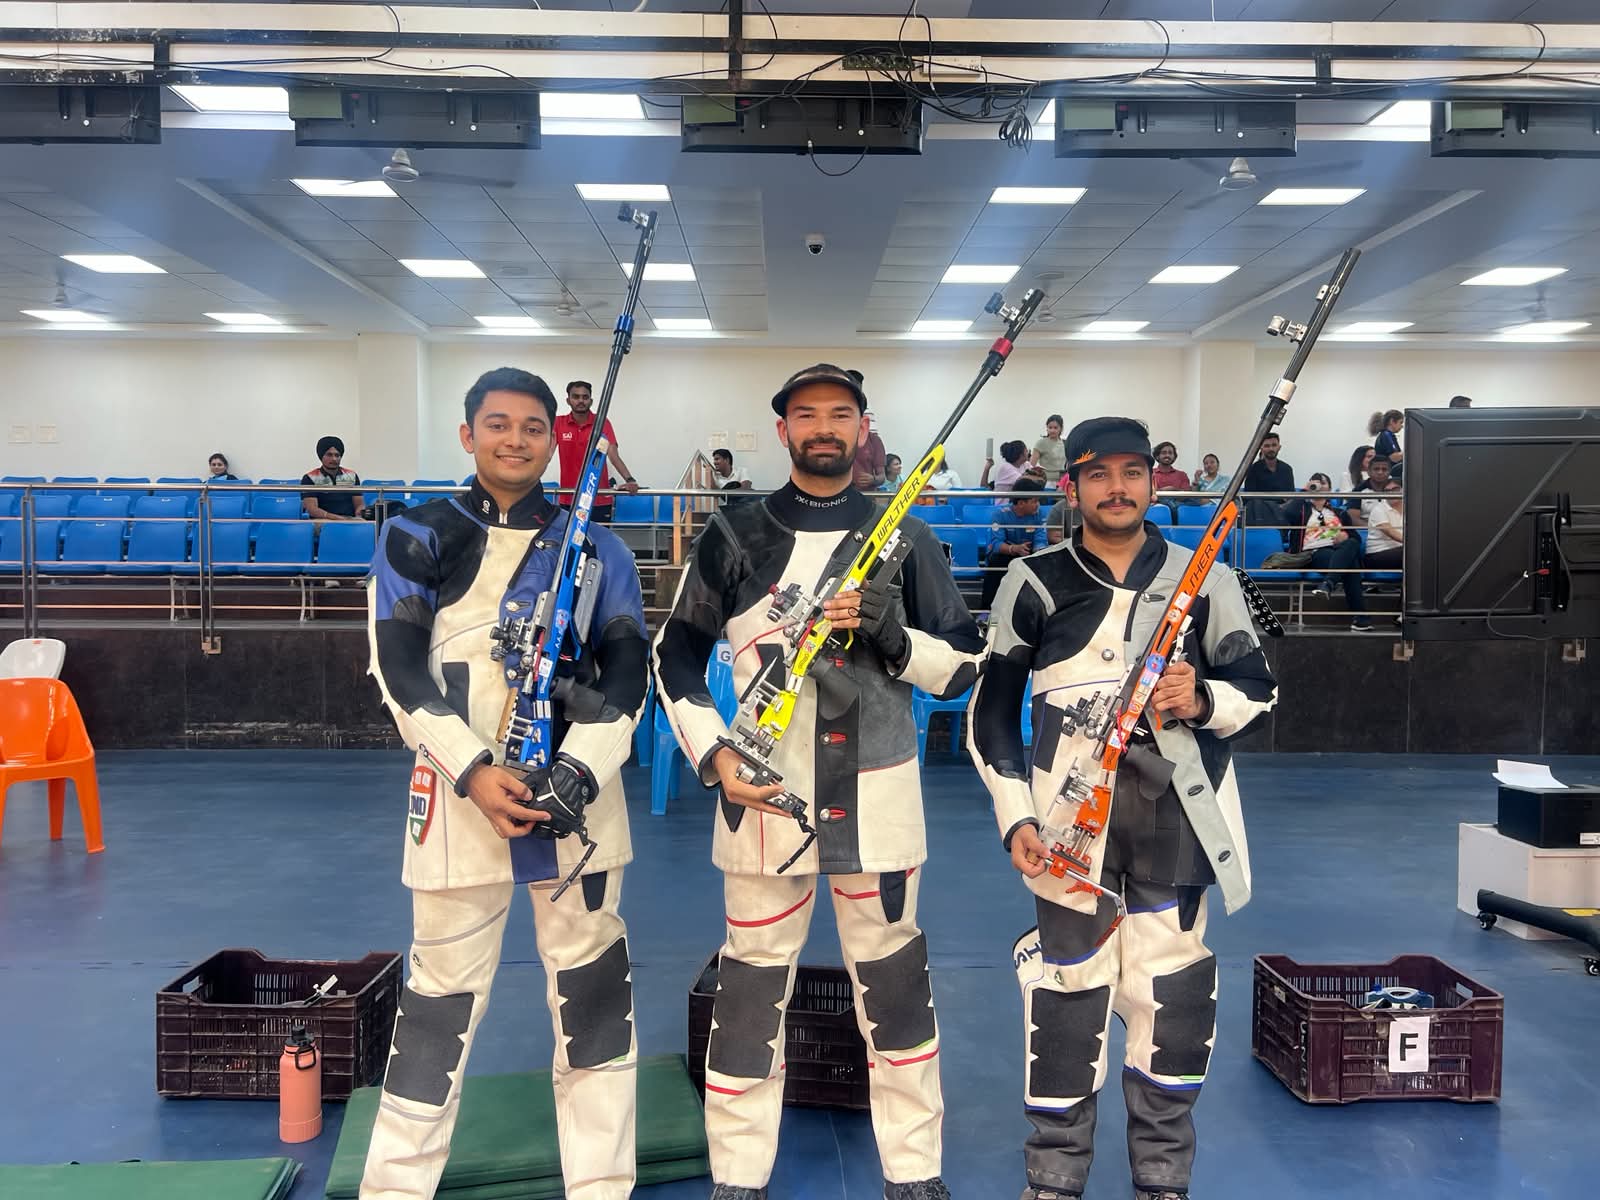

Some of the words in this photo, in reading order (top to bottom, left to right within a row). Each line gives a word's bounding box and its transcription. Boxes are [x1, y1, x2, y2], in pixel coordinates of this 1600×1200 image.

[877, 477, 921, 541] WALTHER
[1182, 543, 1215, 596] LTHER
[720, 650, 731, 662] G
[1399, 1033, 1419, 1062] F
